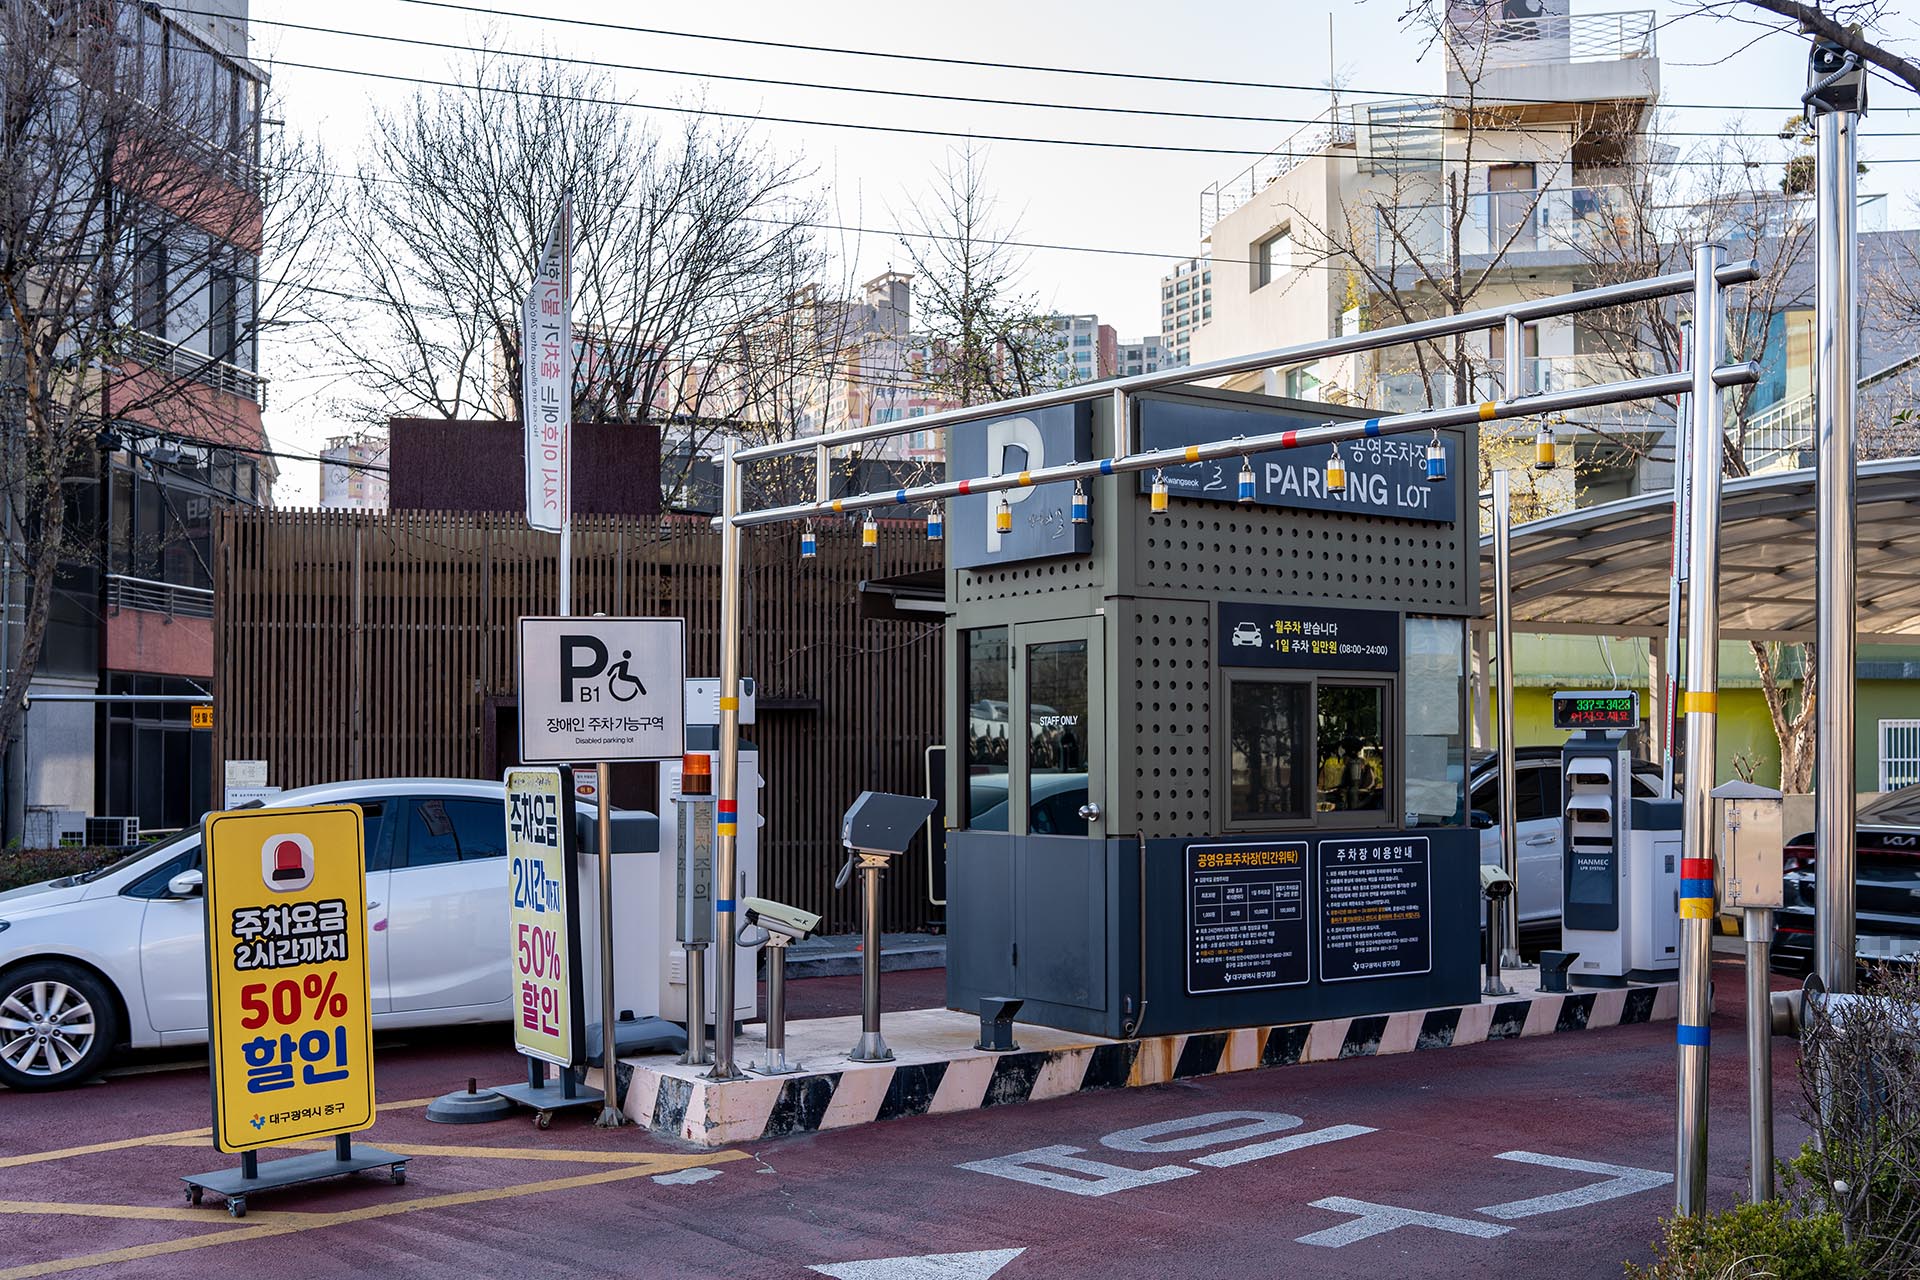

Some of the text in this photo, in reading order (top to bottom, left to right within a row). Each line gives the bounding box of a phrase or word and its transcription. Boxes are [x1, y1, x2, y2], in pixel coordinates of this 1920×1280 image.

[987, 417, 1045, 553] P
[1397, 484, 1431, 508] LOT
[1275, 620, 1337, 636] 월주차 받습니다
[1275, 639, 1388, 655] 1일 주차 일만원 (08:00~24:00)
[560, 635, 608, 702] P
[580, 687, 600, 702] B1
[547, 717, 584, 732] 장애인
[1040, 715, 1078, 726] STAFF ONLY
[510, 792, 557, 847] 주차요금
[1198, 850, 1298, 868] 공영유료주차장(민간위탁)
[513, 857, 560, 913] 2시간까지
[235, 901, 345, 940] 주차요금
[236, 934, 346, 968] 2시간까지
[518, 923, 560, 981] 50%
[241, 971, 347, 1030] 50%
[522, 980, 559, 1037] 할인
[241, 1025, 349, 1094] 할인
[270, 1103, 345, 1125] 대구광역시 중구
